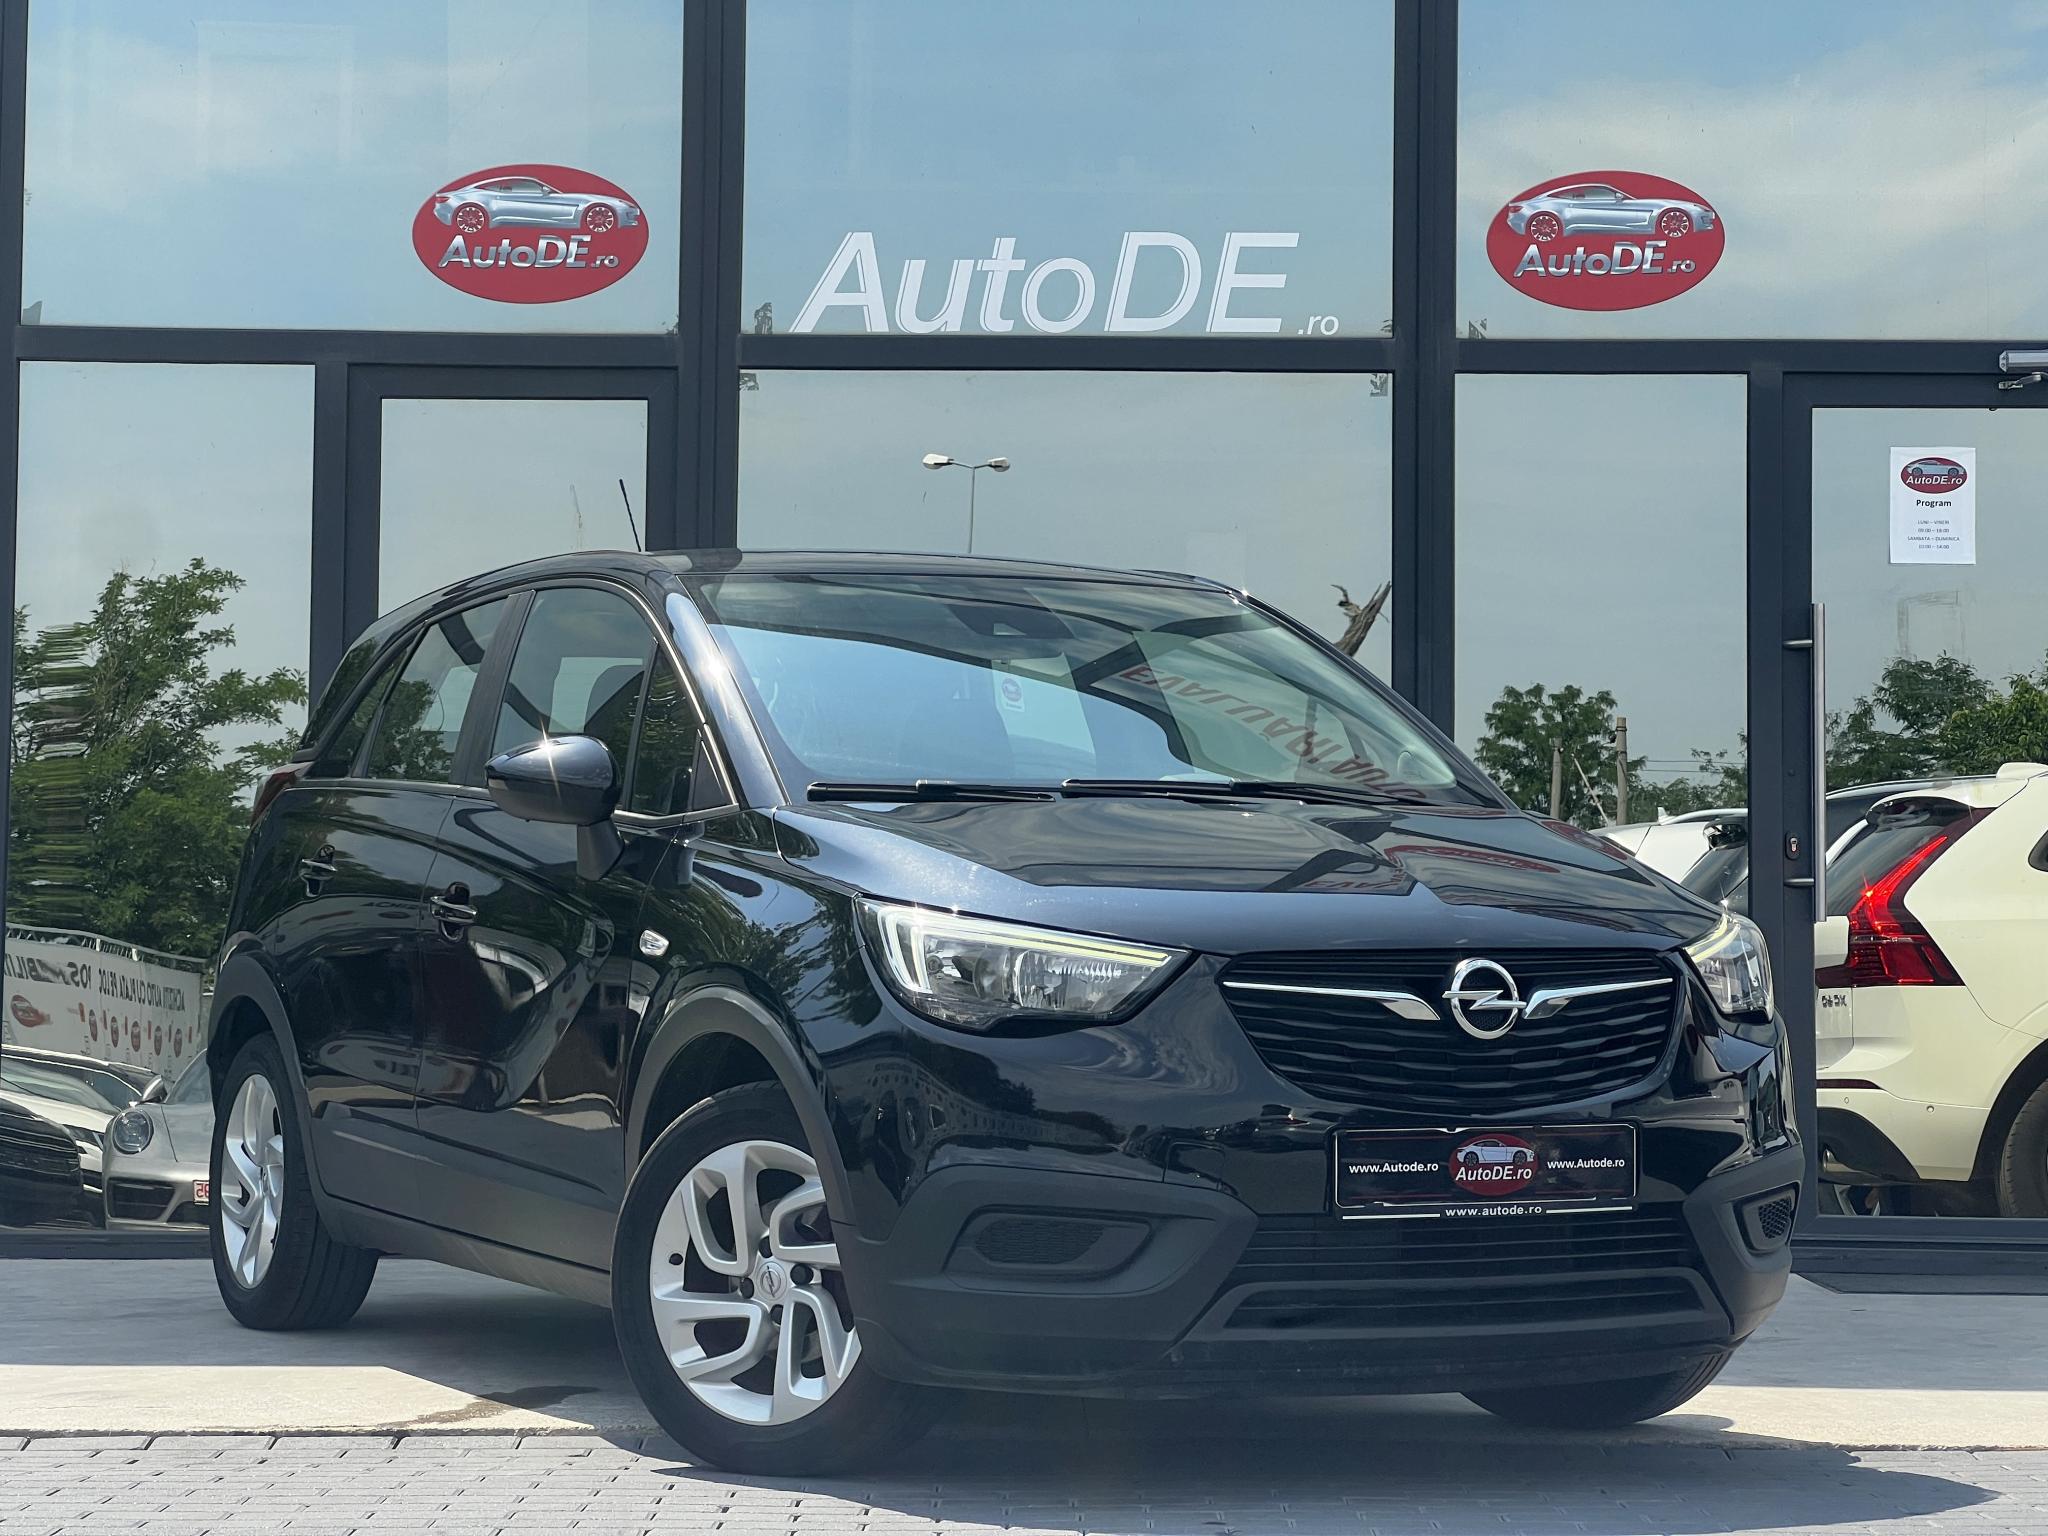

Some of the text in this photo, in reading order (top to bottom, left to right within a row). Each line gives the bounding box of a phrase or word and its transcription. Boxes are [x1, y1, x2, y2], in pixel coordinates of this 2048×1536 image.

[1906, 475, 1963, 485] AutoDE.ro
[1916, 499, 1952, 508] Program
[1349, 1161, 1439, 1174] www.Autode.ro
[1547, 1157, 1625, 1169] www.Autode.ro
[1455, 1165, 1532, 1181] AutoDE.ro
[1445, 1204, 1542, 1217] www.autode.ro
